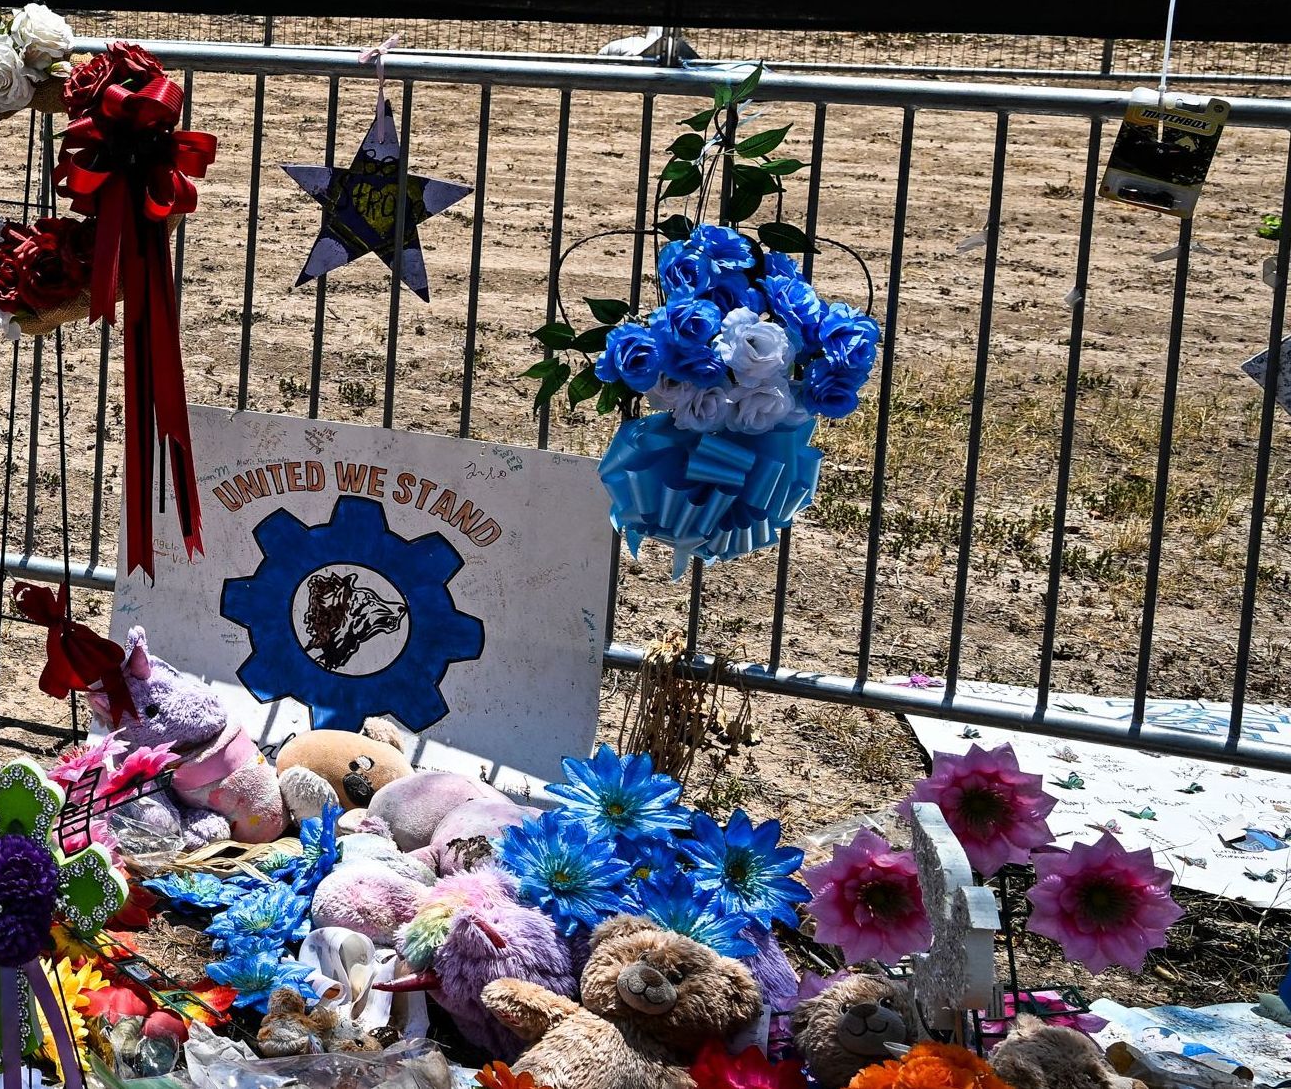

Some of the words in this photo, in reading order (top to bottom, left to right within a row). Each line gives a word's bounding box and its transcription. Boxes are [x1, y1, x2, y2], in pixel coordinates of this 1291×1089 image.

[212, 460, 326, 513] UNITED
[334, 461, 388, 498] WE
[392, 472, 503, 548] STAND
